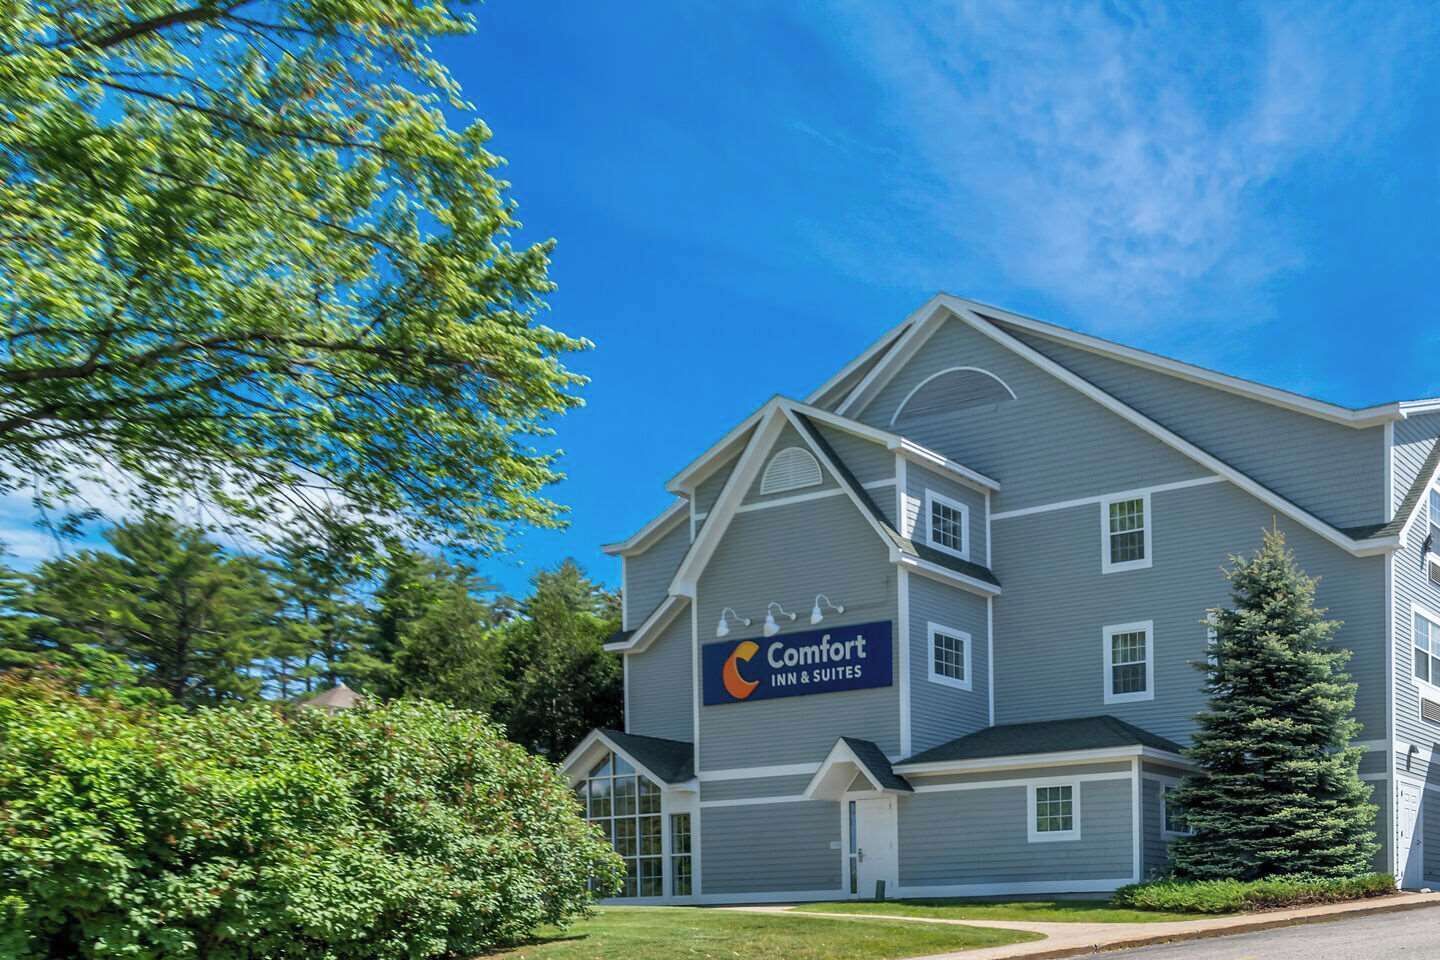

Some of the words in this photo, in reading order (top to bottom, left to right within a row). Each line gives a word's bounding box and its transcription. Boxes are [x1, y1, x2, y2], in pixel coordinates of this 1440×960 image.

[767, 634, 867, 669] Comfort
[771, 672, 797, 687] INN
[800, 671, 810, 683] &
[813, 664, 862, 682] SUITES
